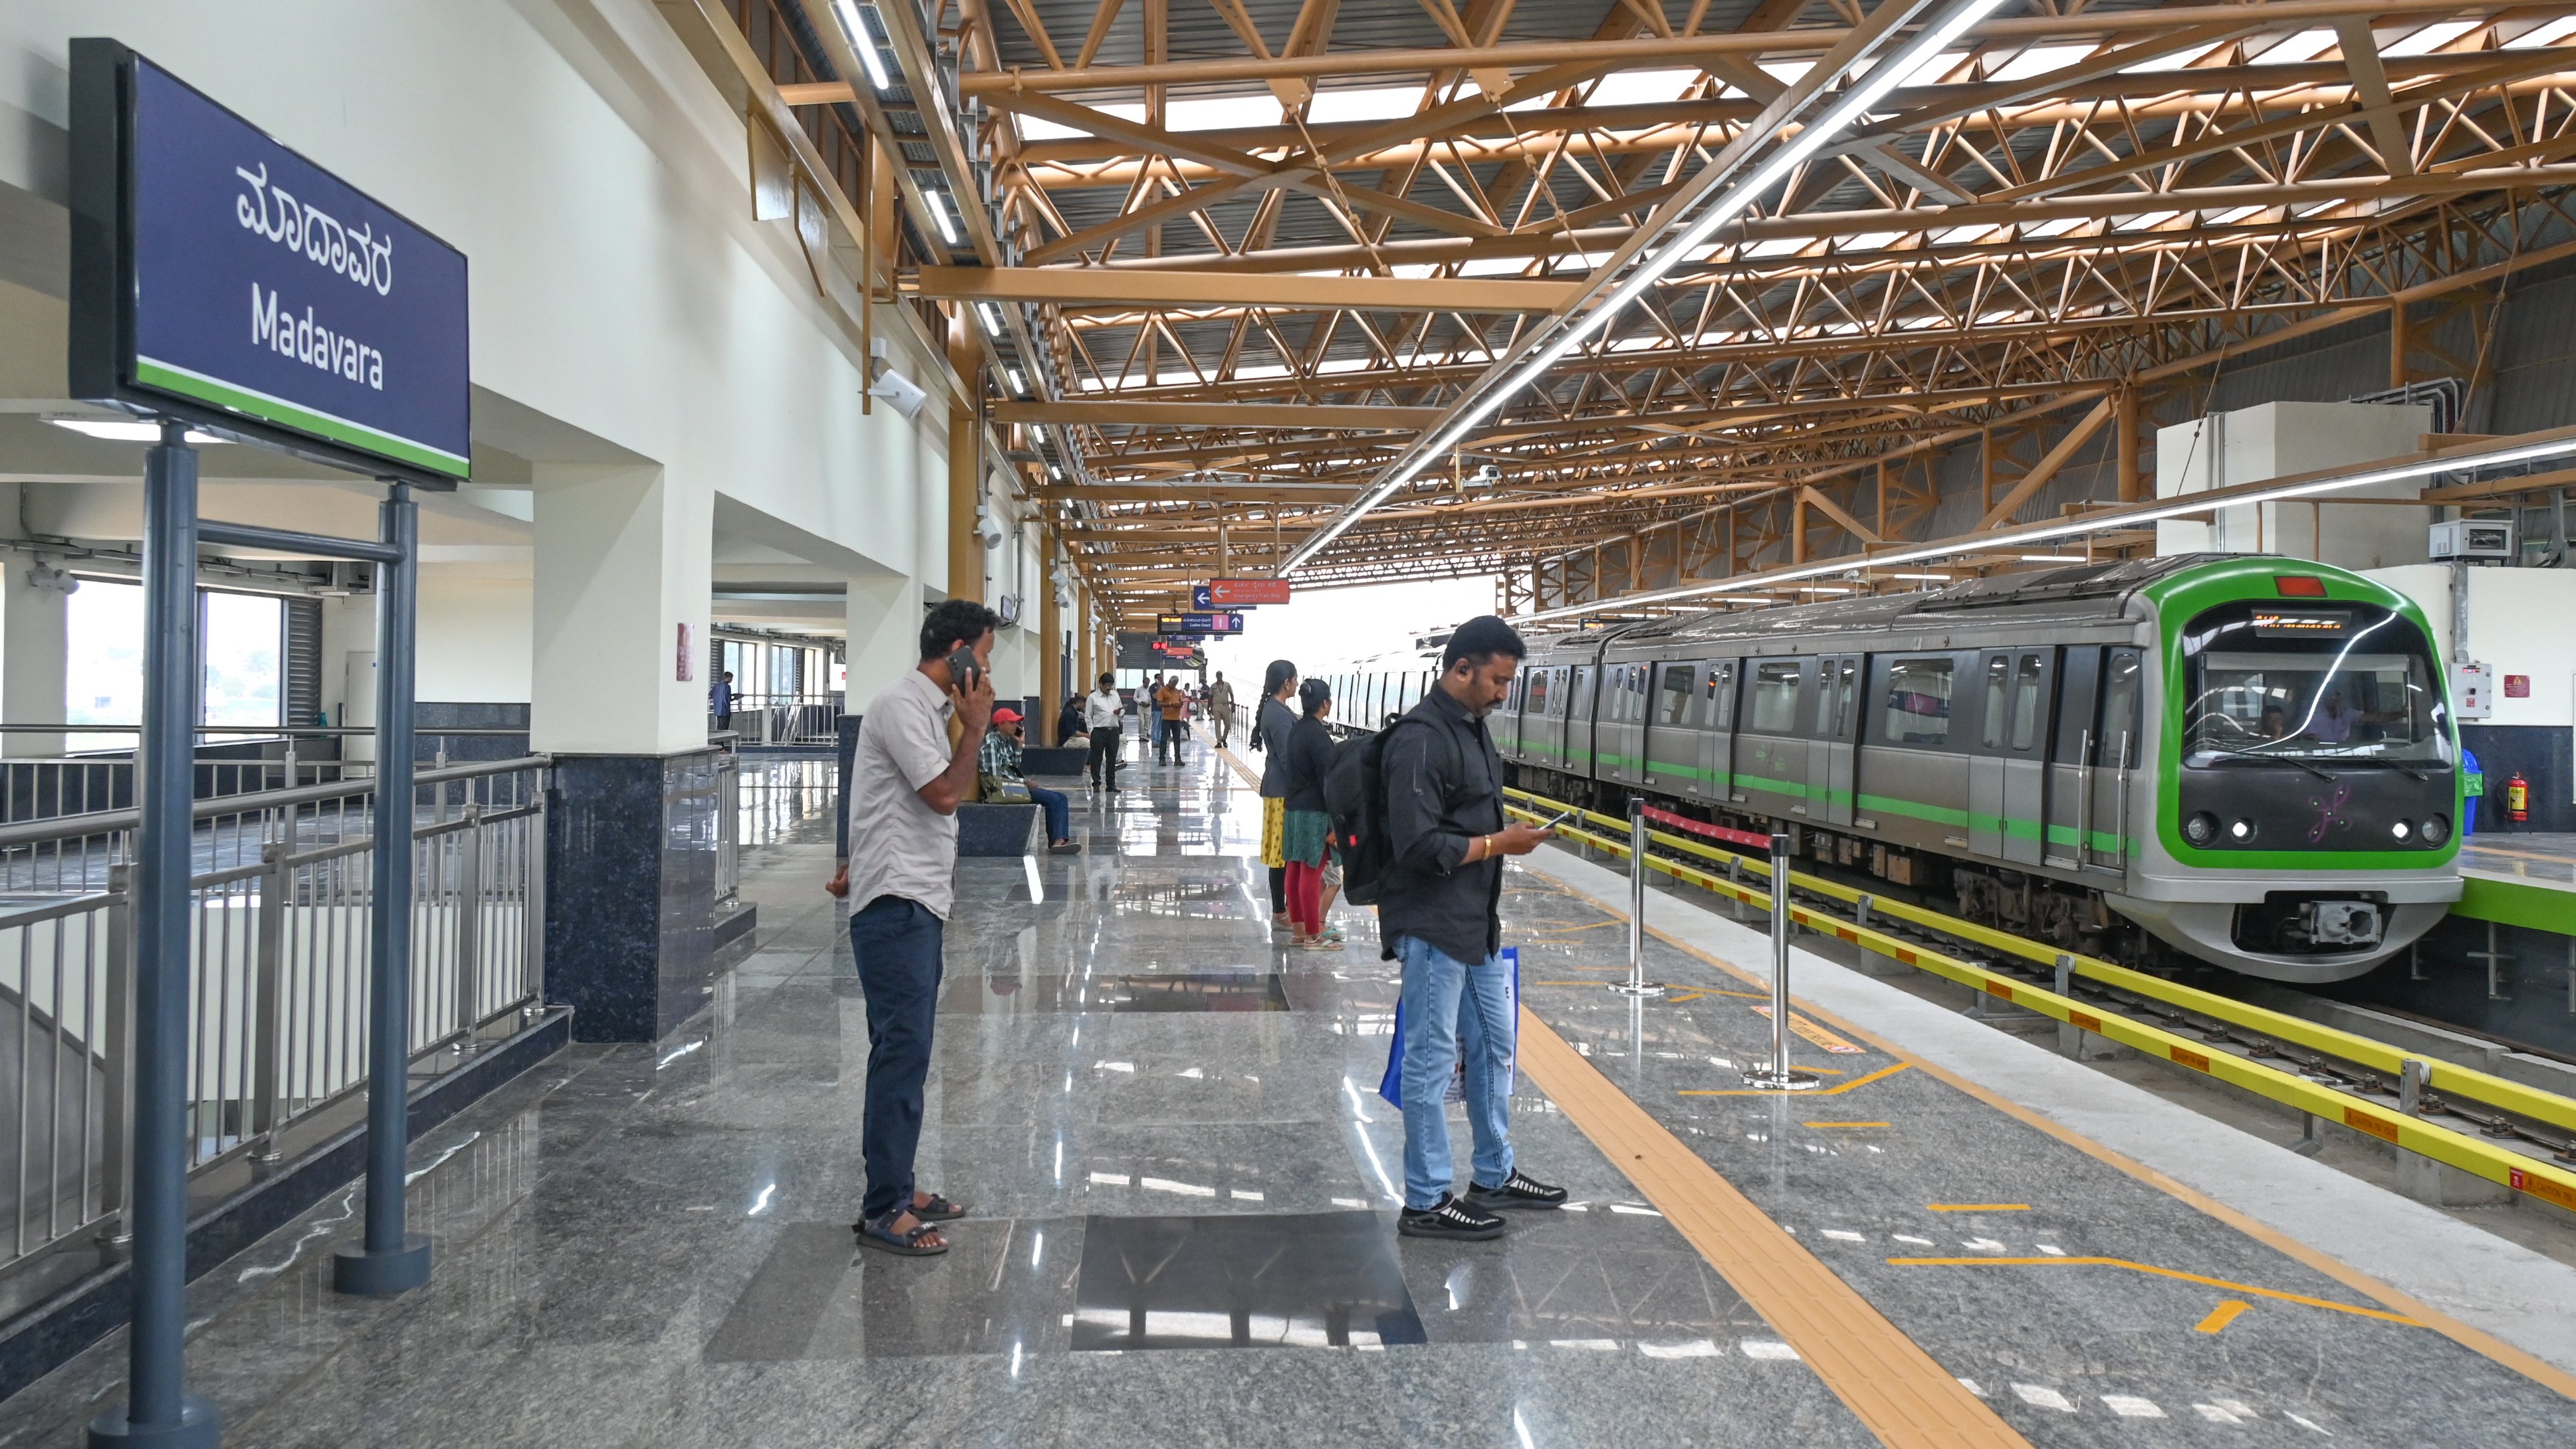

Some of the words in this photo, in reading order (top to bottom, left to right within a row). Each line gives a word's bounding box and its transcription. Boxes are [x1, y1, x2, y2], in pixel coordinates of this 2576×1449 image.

[235, 162, 392, 296] ಮಾದಾವರ
[251, 282, 384, 391] Madavara
[2536, 1182, 2561, 1198] CAUTION
